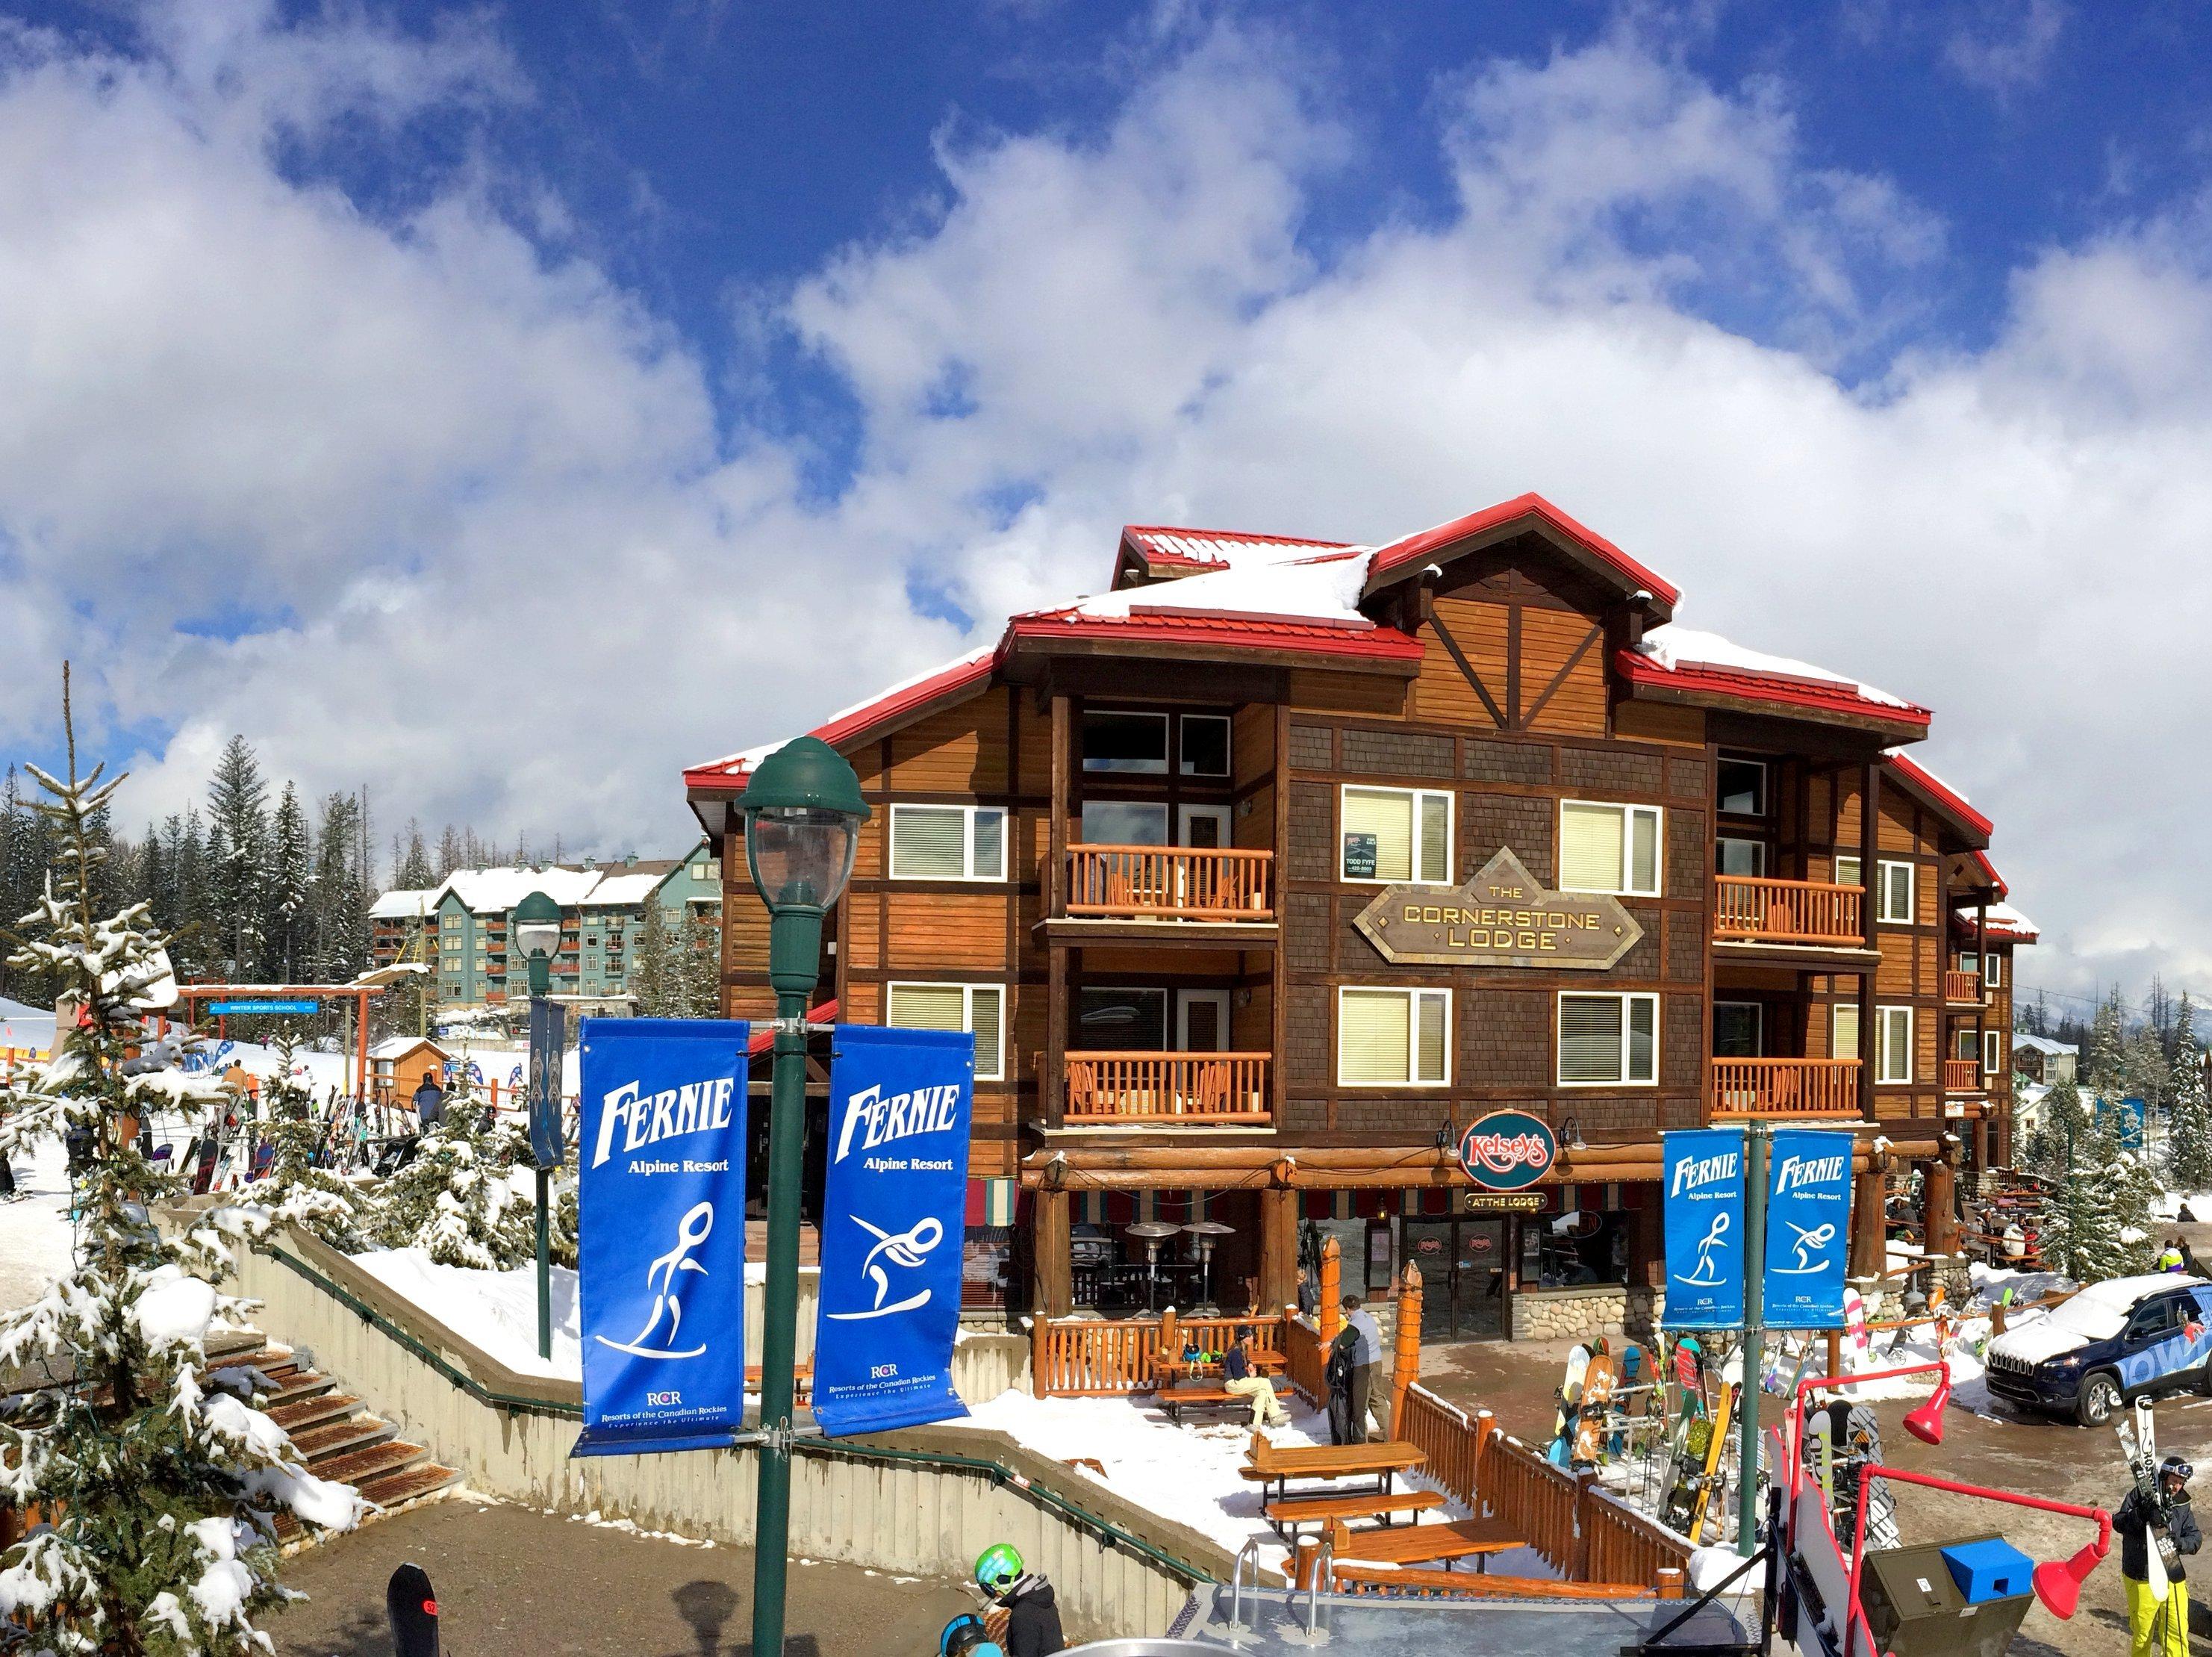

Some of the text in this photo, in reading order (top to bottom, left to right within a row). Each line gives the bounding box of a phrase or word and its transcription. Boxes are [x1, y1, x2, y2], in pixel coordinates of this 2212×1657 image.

[1489, 886, 1523, 898] THE
[1403, 905, 1601, 930] CORNERSTONE
[1448, 927, 1557, 951] LODGE
[592, 1077, 734, 1169] FERNIE
[835, 1084, 960, 1165] FERNIE
[1468, 1133, 1548, 1172] Kelsey's
[628, 1159, 729, 1176] Alpine Resort
[863, 1157, 953, 1172] Alpine Resort
[1671, 1152, 1738, 1199] FERNIE
[1775, 1155, 1844, 1195] FERNIE
[1508, 1197, 1539, 1207] LODGE
[1688, 1192, 1713, 1201] Alpine
[1792, 1192, 1842, 1201] Alpine Resort
[871, 1364, 898, 1378] RCR
[829, 1384, 856, 1393] Resorts
[879, 1379, 911, 1389] Canadian
[912, 1375, 936, 1384] Rockies
[647, 1391, 682, 1406] RCR
[602, 1414, 631, 1423] Resorts
[658, 1408, 697, 1419] Canadian
[699, 1406, 727, 1415] Rockies
[608, 1420, 658, 1428] Experience
[427, 1602, 435, 1613] 52
